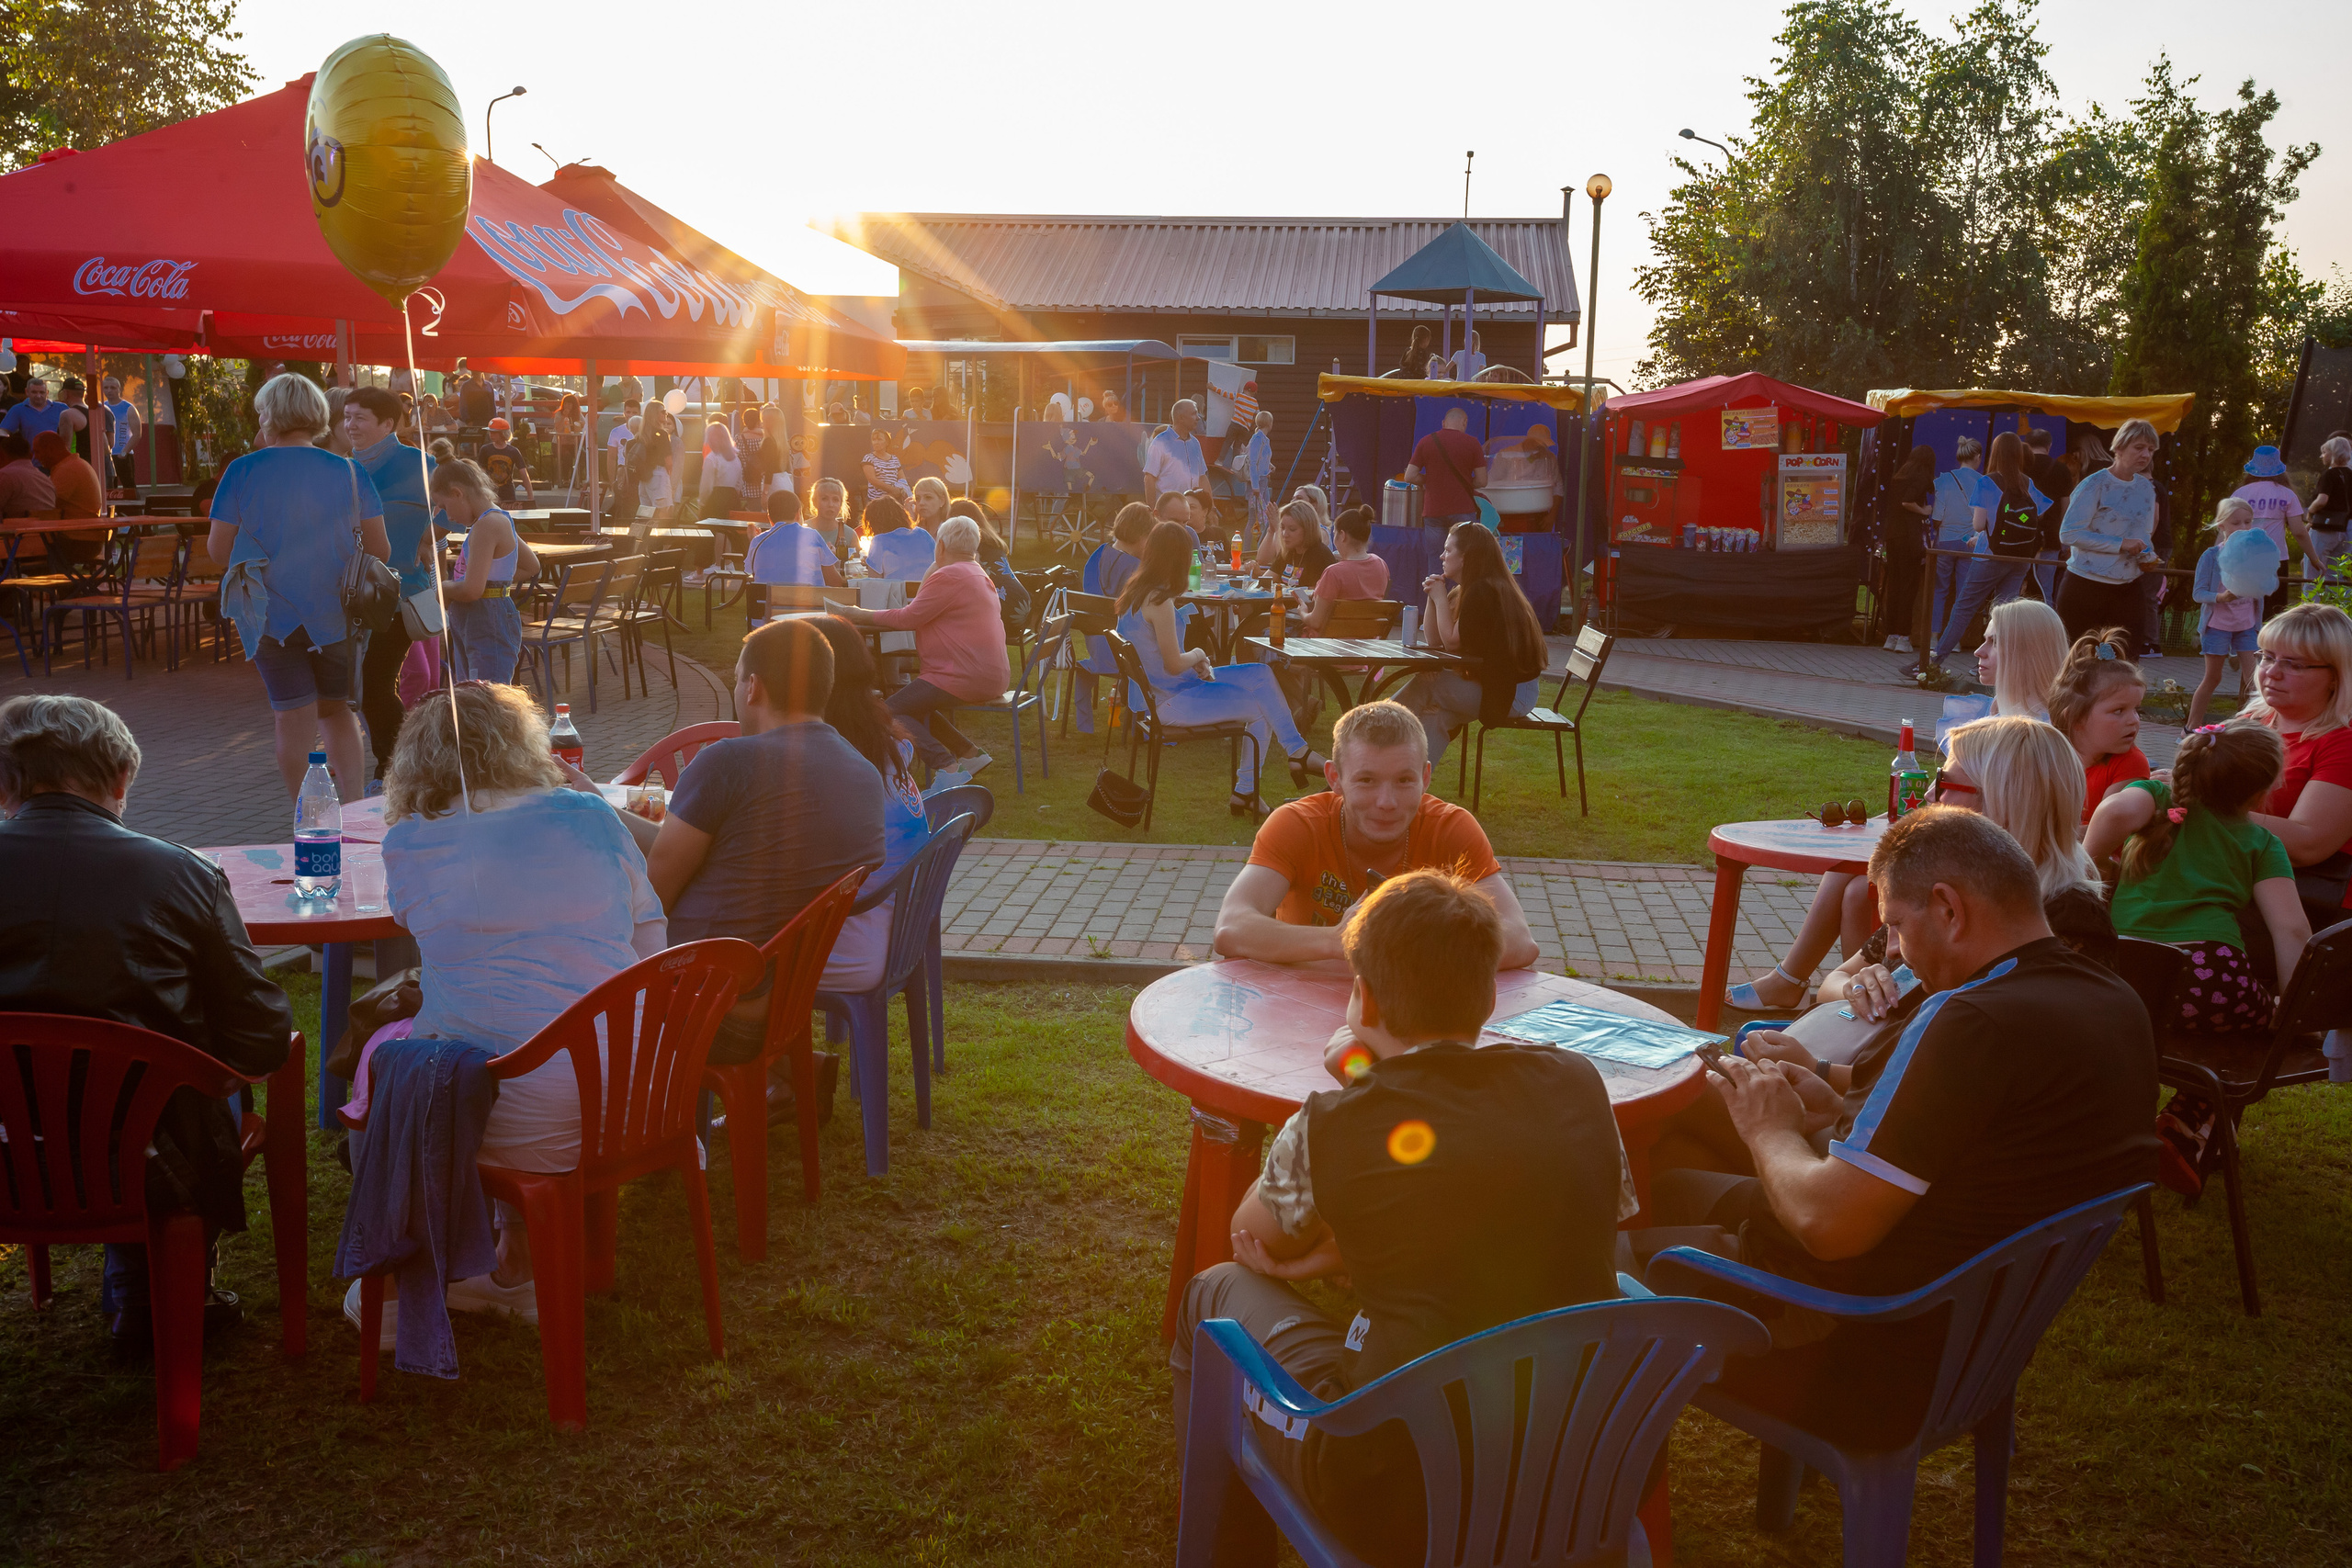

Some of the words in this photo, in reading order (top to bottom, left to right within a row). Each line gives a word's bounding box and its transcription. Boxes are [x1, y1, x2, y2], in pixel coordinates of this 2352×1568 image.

[74, 256, 198, 299] Coca-Cola
[1786, 457, 1804, 468] POP
[1814, 457, 1839, 468] CORN
[1618, 522, 1652, 539] POPCORN
[1321, 872, 1348, 891] the
